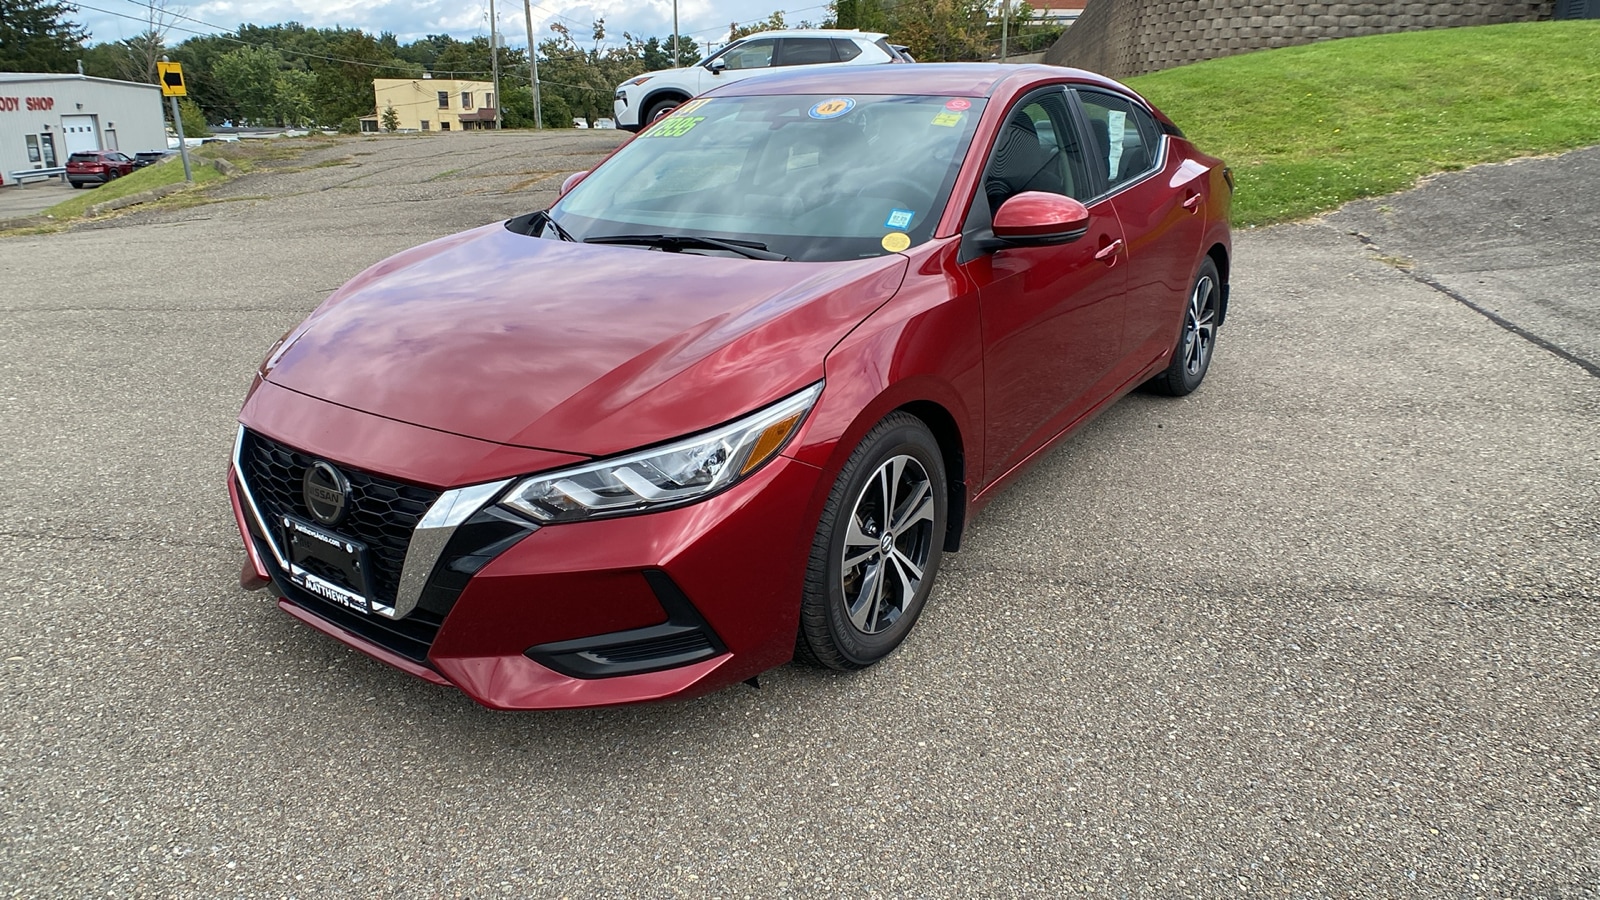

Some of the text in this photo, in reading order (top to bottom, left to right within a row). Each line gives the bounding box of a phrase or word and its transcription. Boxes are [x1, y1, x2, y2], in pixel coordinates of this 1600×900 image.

[26, 97, 54, 111] SHOP
[309, 486, 339, 504] NISSAN
[305, 579, 350, 607] MATTHEWS
